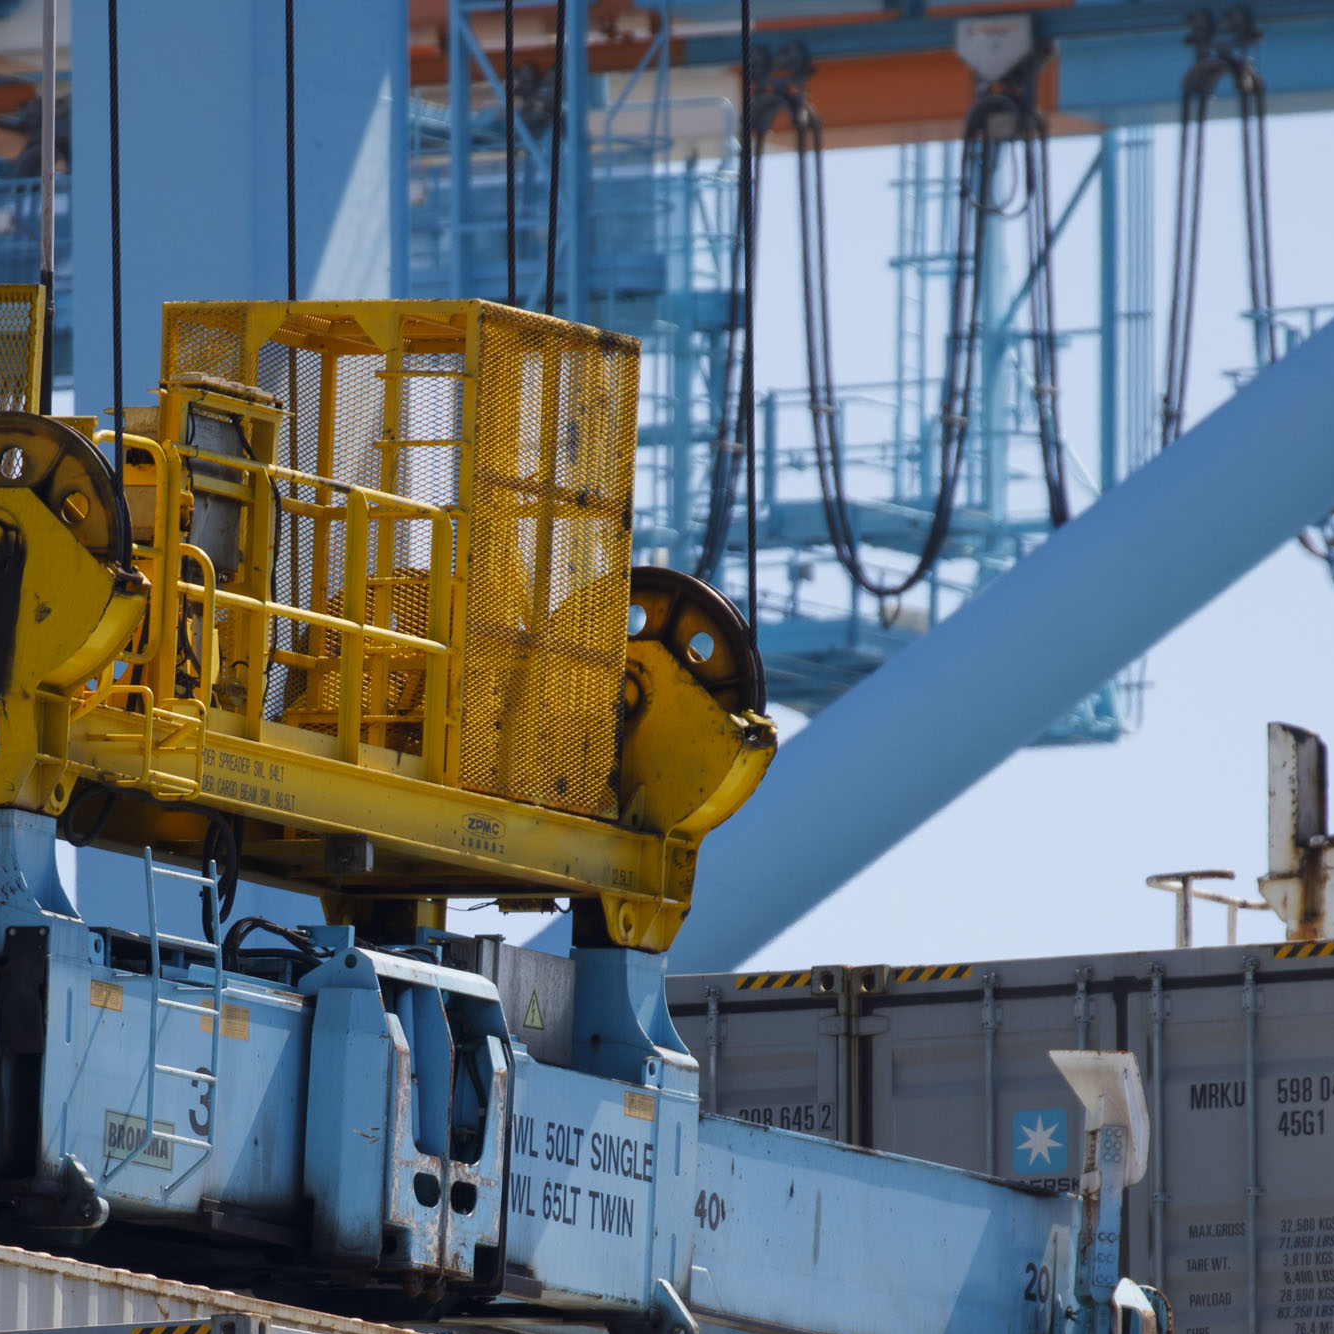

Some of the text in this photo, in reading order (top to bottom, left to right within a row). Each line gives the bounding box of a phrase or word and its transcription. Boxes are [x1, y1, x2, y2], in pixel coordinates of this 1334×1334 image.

[218, 752, 250, 775] SPREADER
[468, 817, 499, 835] ZPMC
[189, 1067, 213, 1136] 3
[1190, 1081, 1246, 1110] MRKU
[1277, 1078, 1313, 1104] 598
[780, 1105, 814, 1132] 645
[1278, 1109, 1325, 1136] 45G1
[545, 1121, 585, 1167] 50LT
[591, 1131, 654, 1183] SINGLE
[543, 1181, 581, 1226] 65LT
[589, 1190, 634, 1238] TWIN
[1316, 1235, 1334, 1248] LBS
[1186, 1257, 1231, 1272] TARE WT.
[1315, 1251, 1334, 1265] KGS
[1024, 1262, 1051, 1304] 20
[1316, 1269, 1334, 1283] LBS
[1189, 1292, 1232, 1307] PAYLOAD
[1315, 1304, 1334, 1318] LBS
